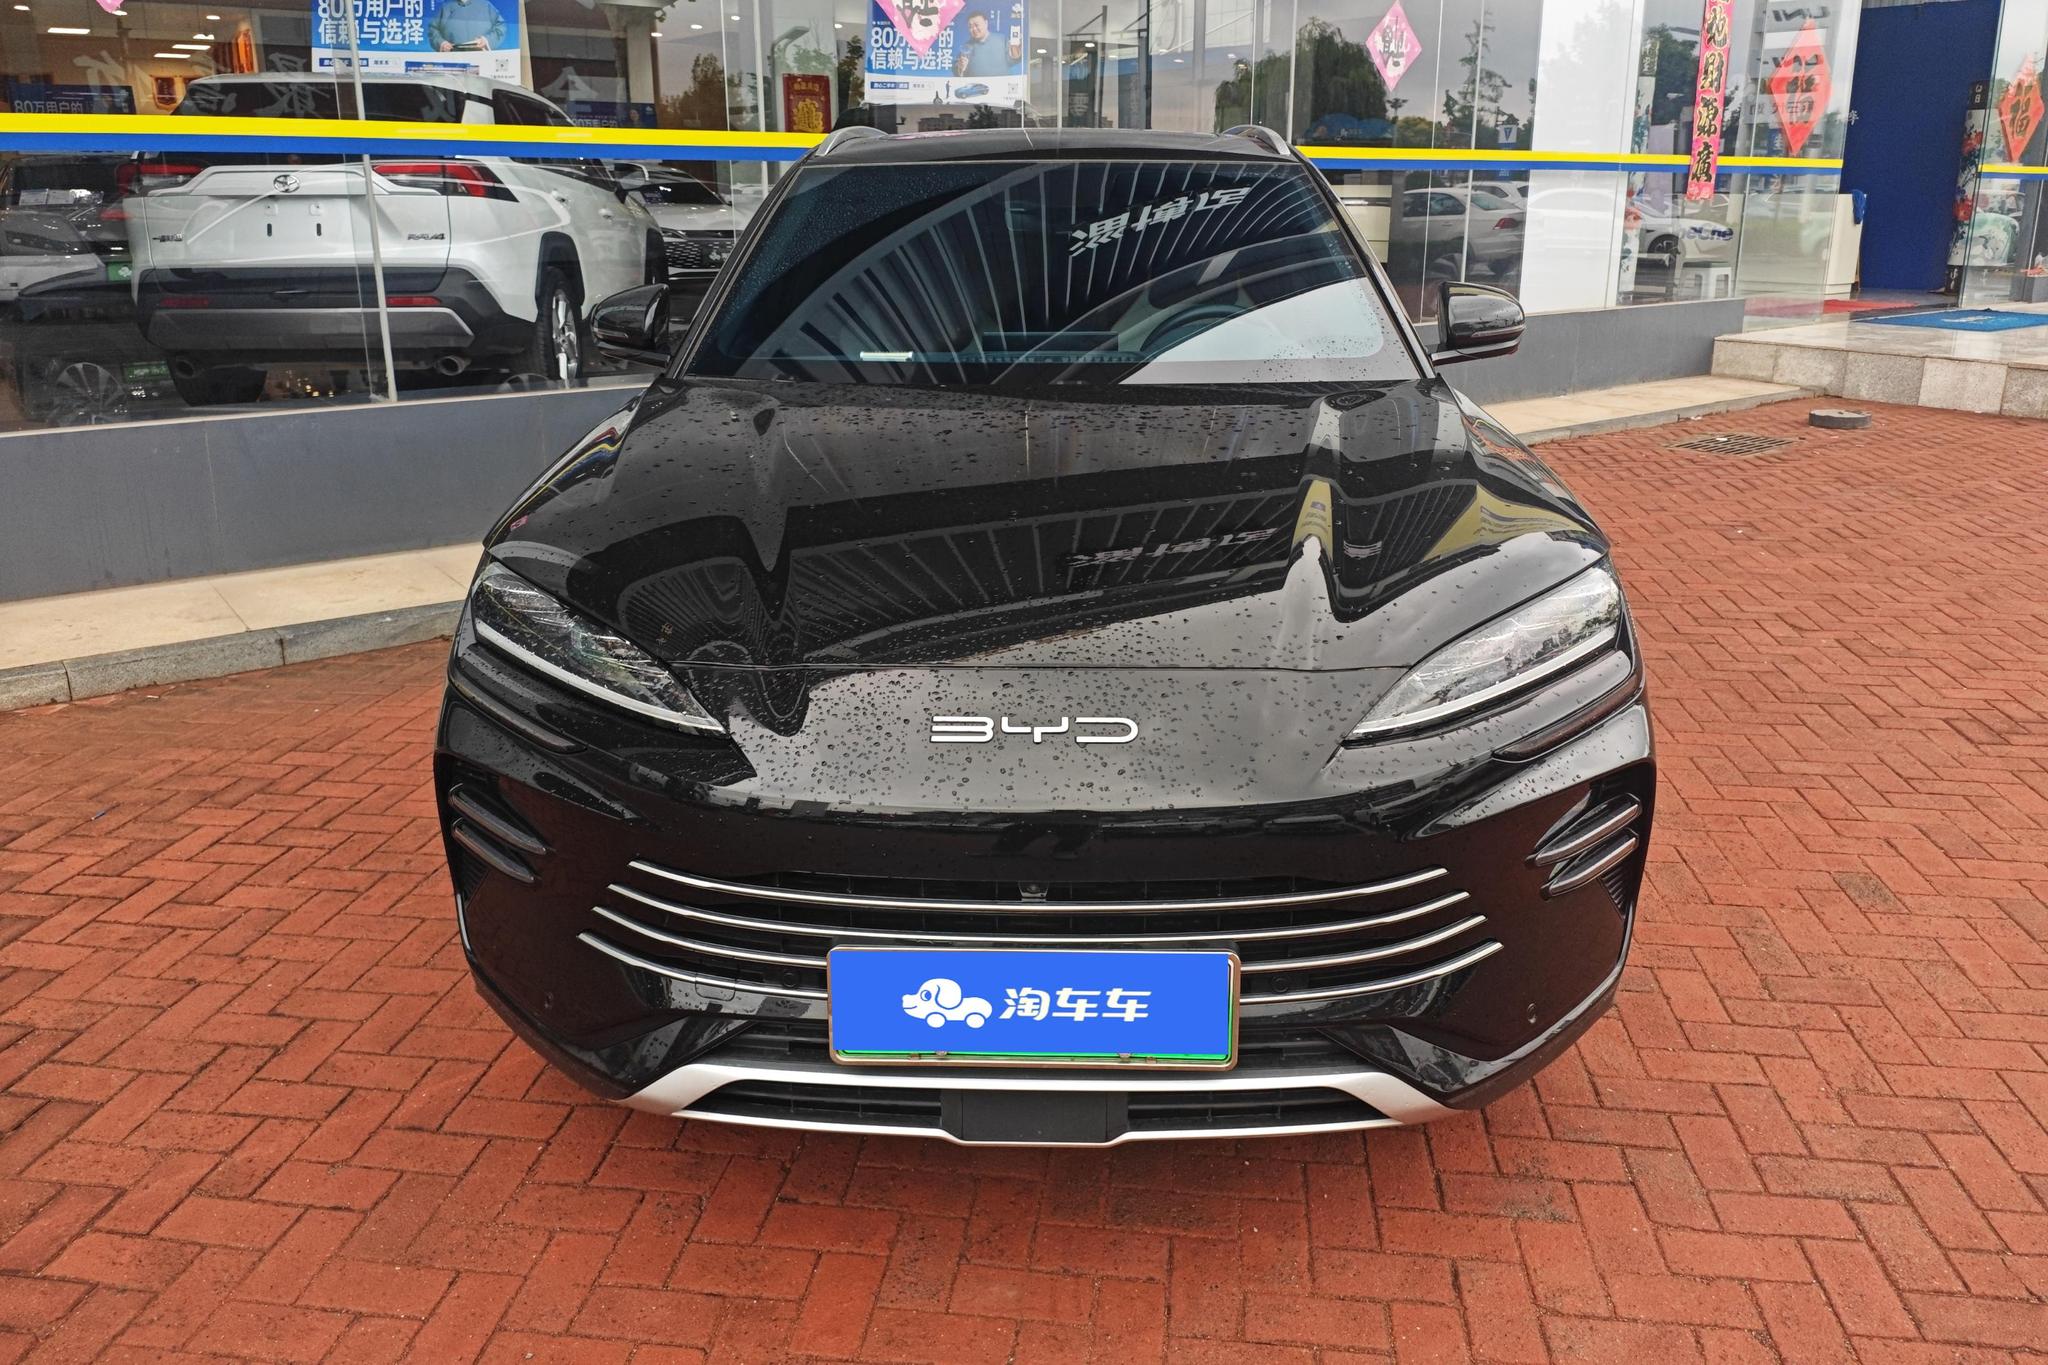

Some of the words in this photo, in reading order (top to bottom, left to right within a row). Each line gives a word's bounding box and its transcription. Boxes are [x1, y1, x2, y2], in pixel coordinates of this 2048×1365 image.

[318, 18, 425, 45] 信赖与选择
[870, 26, 954, 48] 80万的
[930, 716, 1139, 743] BYD
